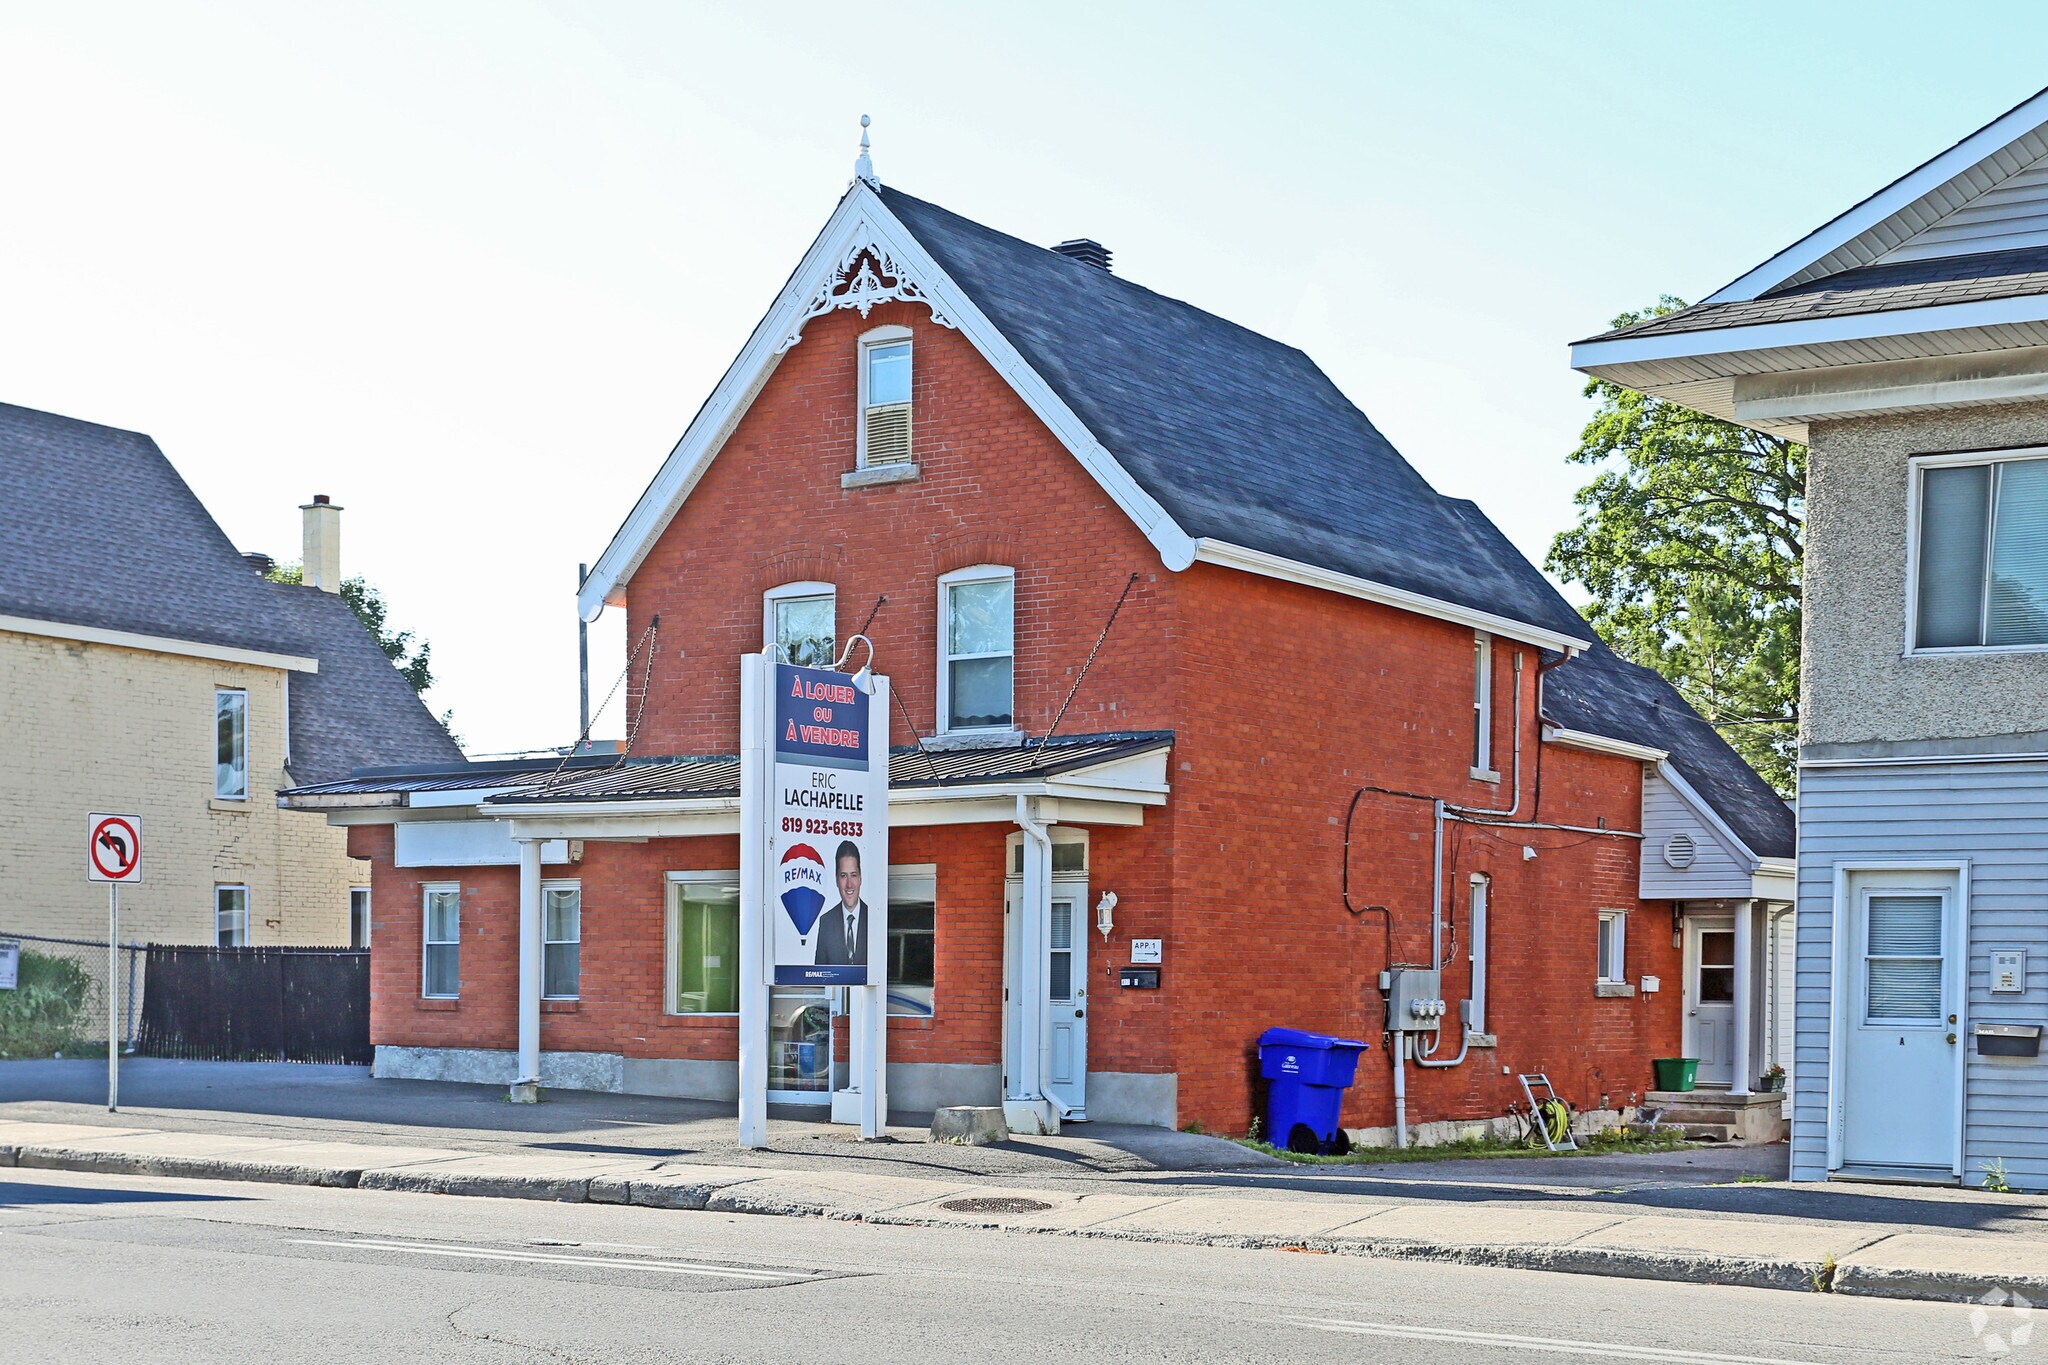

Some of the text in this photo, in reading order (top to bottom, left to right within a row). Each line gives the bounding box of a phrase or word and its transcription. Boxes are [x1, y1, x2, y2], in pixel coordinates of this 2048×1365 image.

[791, 674, 855, 705] À LOUER
[813, 706, 832, 723] OU
[785, 718, 859, 749] À VENDRE
[811, 771, 837, 790] ERIC
[784, 788, 864, 812] LACHAPELLE
[781, 816, 864, 838] 819 923-6833
[784, 867, 822, 885] RE/MAX
[805, 970, 823, 978] RE/MAX
[1899, 1037, 1905, 1046] A
